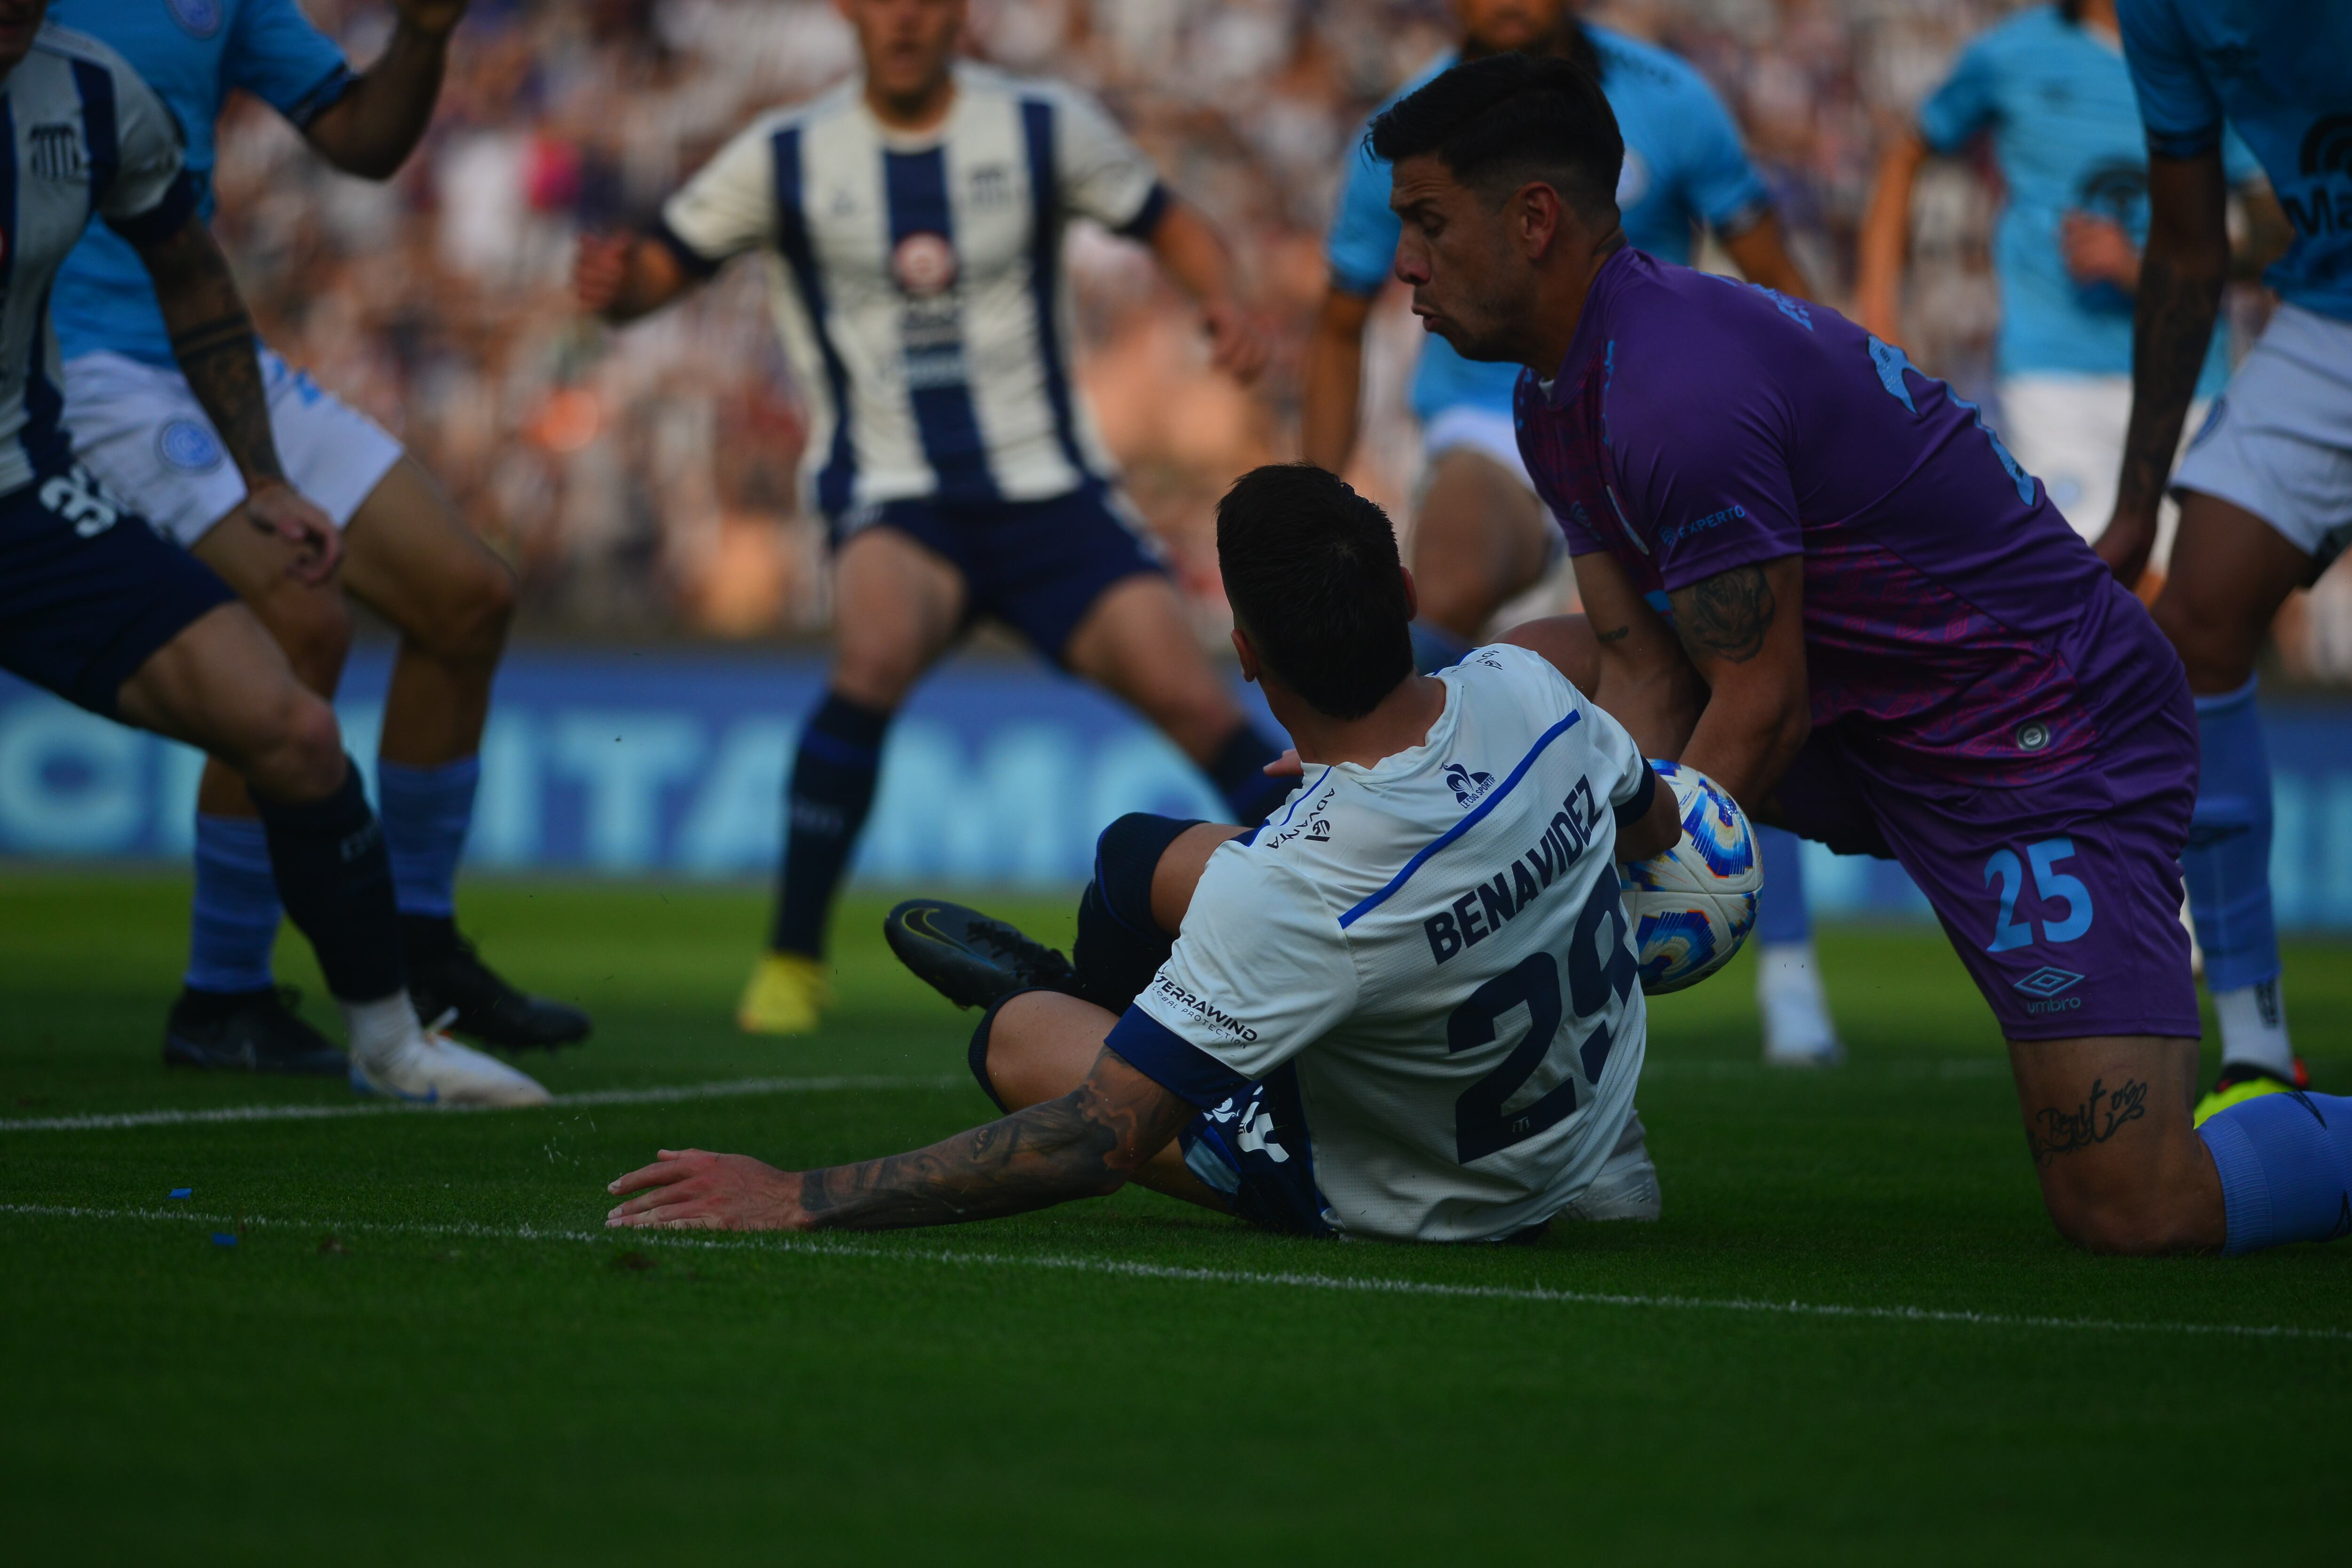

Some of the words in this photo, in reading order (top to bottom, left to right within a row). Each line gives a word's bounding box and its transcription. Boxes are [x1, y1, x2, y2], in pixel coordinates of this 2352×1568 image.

[1678, 504, 1746, 539] EXPERTO
[1266, 788, 1335, 849] ADVANTA
[1460, 801, 1470, 809] LE
[1466, 793, 1479, 803] COQ
[1476, 774, 1496, 796] SPORTIF
[1424, 774, 1602, 965] BENAVIDEZ
[1985, 836, 2094, 953] 25
[1152, 985, 1179, 1009] LOBAL
[1181, 1008, 1248, 1049] PROTECTION
[1155, 975, 1257, 1042] TERRAWIND
[1447, 861, 1639, 1164] 29
[2027, 996, 2081, 1015] umbro
